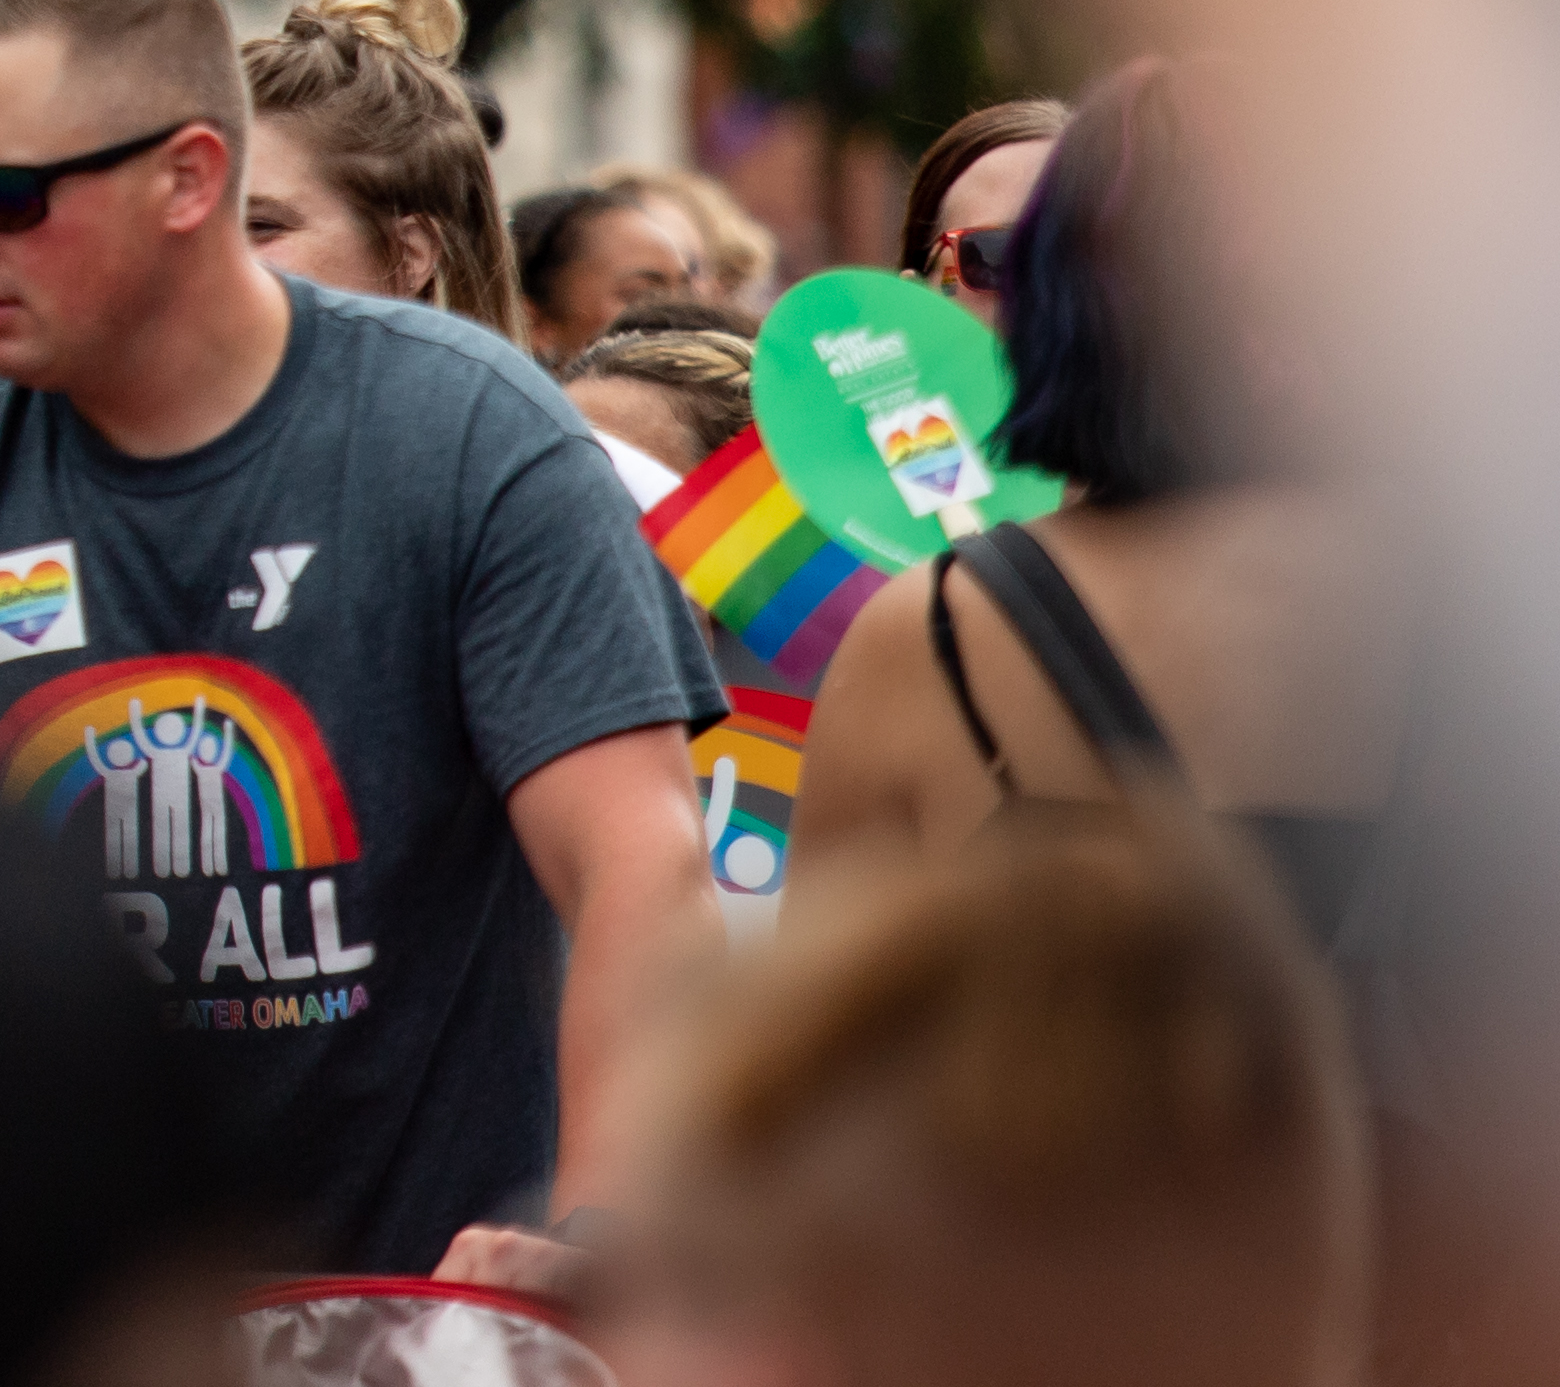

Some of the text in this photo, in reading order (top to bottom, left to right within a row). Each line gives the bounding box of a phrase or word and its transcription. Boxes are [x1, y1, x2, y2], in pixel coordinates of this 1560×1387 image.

[248, 542, 317, 631] Y
[200, 877, 377, 982] ALL
[252, 984, 369, 1030] OMAHA
